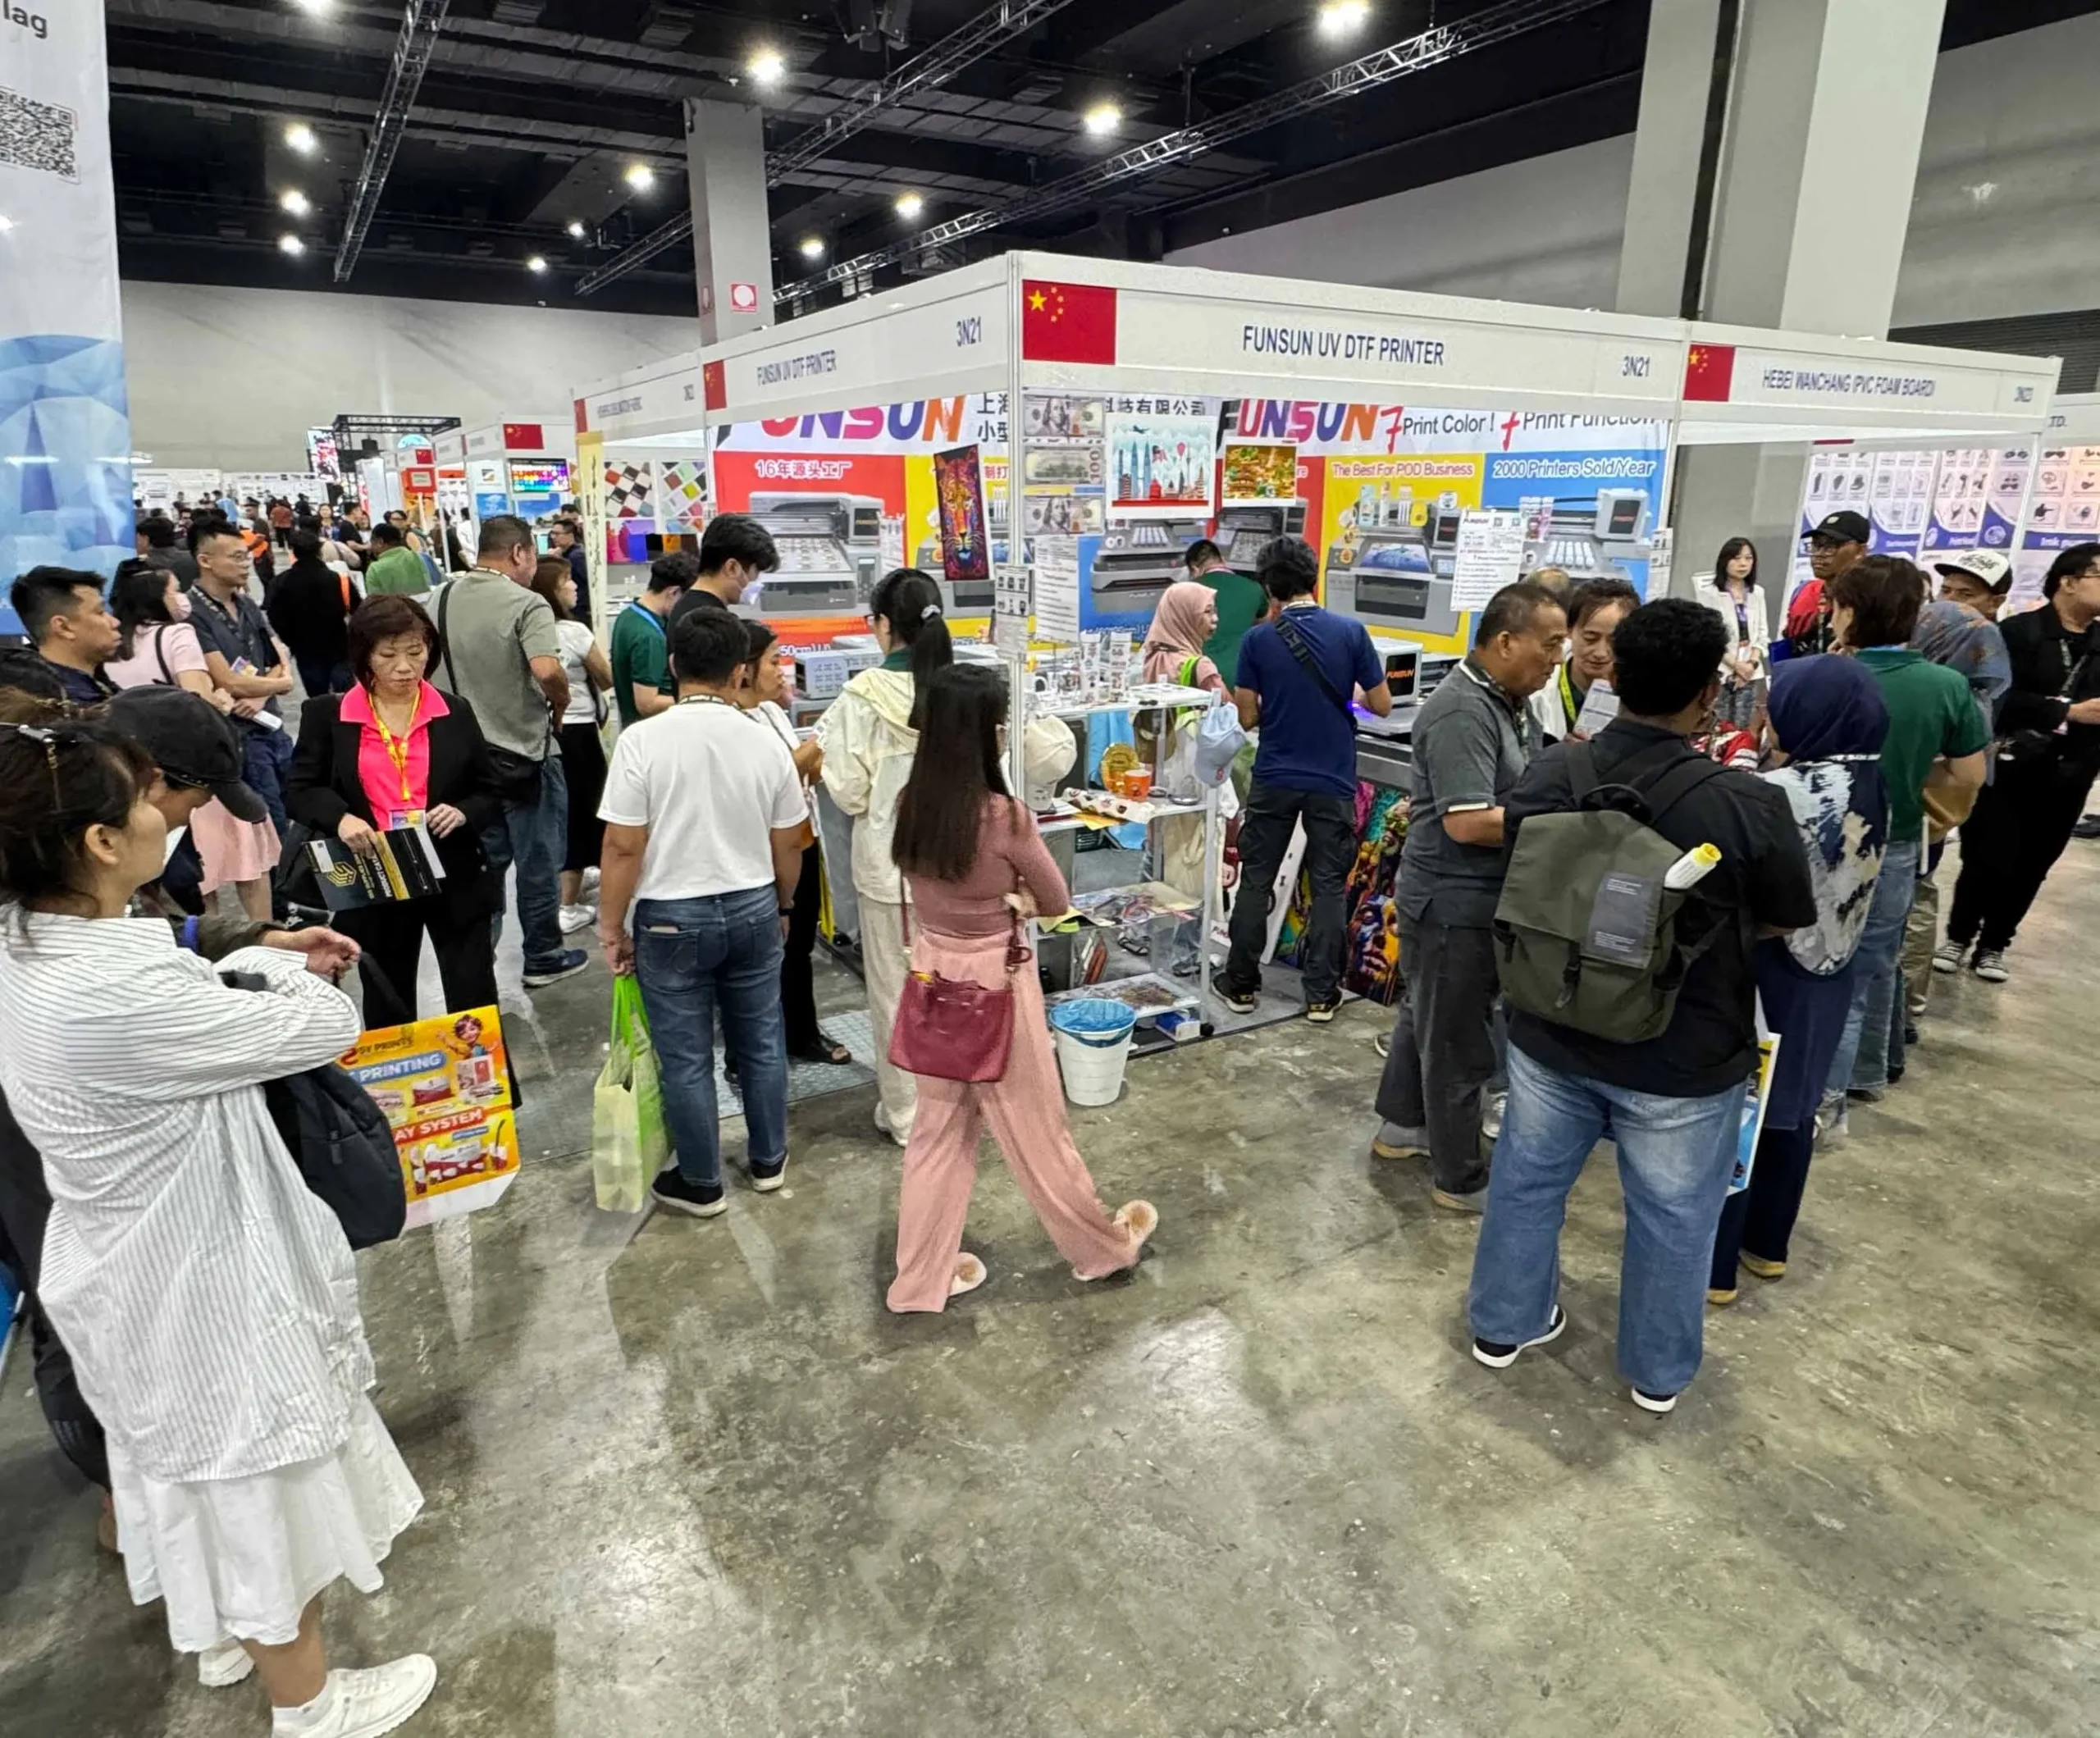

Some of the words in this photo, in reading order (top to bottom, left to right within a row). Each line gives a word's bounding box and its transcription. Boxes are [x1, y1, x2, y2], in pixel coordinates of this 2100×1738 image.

[956, 316, 983, 347] 3N21
[1242, 325, 1313, 356] FUNSUN
[1317, 331, 1341, 358] UV
[1344, 334, 1376, 361] DTF
[1379, 336, 1445, 366] PRINTER
[757, 363, 782, 386] FUNSUN
[806, 349, 837, 376] PRINTER
[1622, 355, 1650, 377] 3N21
[1762, 368, 1794, 390] HEBEI
[1796, 371, 1851, 393] WANCHANG
[1874, 376, 1901, 395] FOAM
[1216, 398, 1380, 451] FUNSUN
[1403, 415, 1439, 436] Print
[1442, 413, 1486, 434] Color
[2048, 414, 2067, 428] TD.
[755, 459, 852, 479] 16年源头工厂
[1332, 463, 1352, 477] The
[1353, 463, 1376, 477] Best
[1377, 462, 1395, 477] For
[1396, 462, 1422, 477] POD
[1424, 461, 1474, 477] Business
[1493, 462, 1526, 477] 2000
[1528, 460, 1580, 477] Printers
[1582, 458, 1654, 477] Sold/Year
[358, 1052, 442, 1082] PRINTING
[394, 1124, 416, 1143] AY
[419, 1107, 483, 1135] SYSTEM
